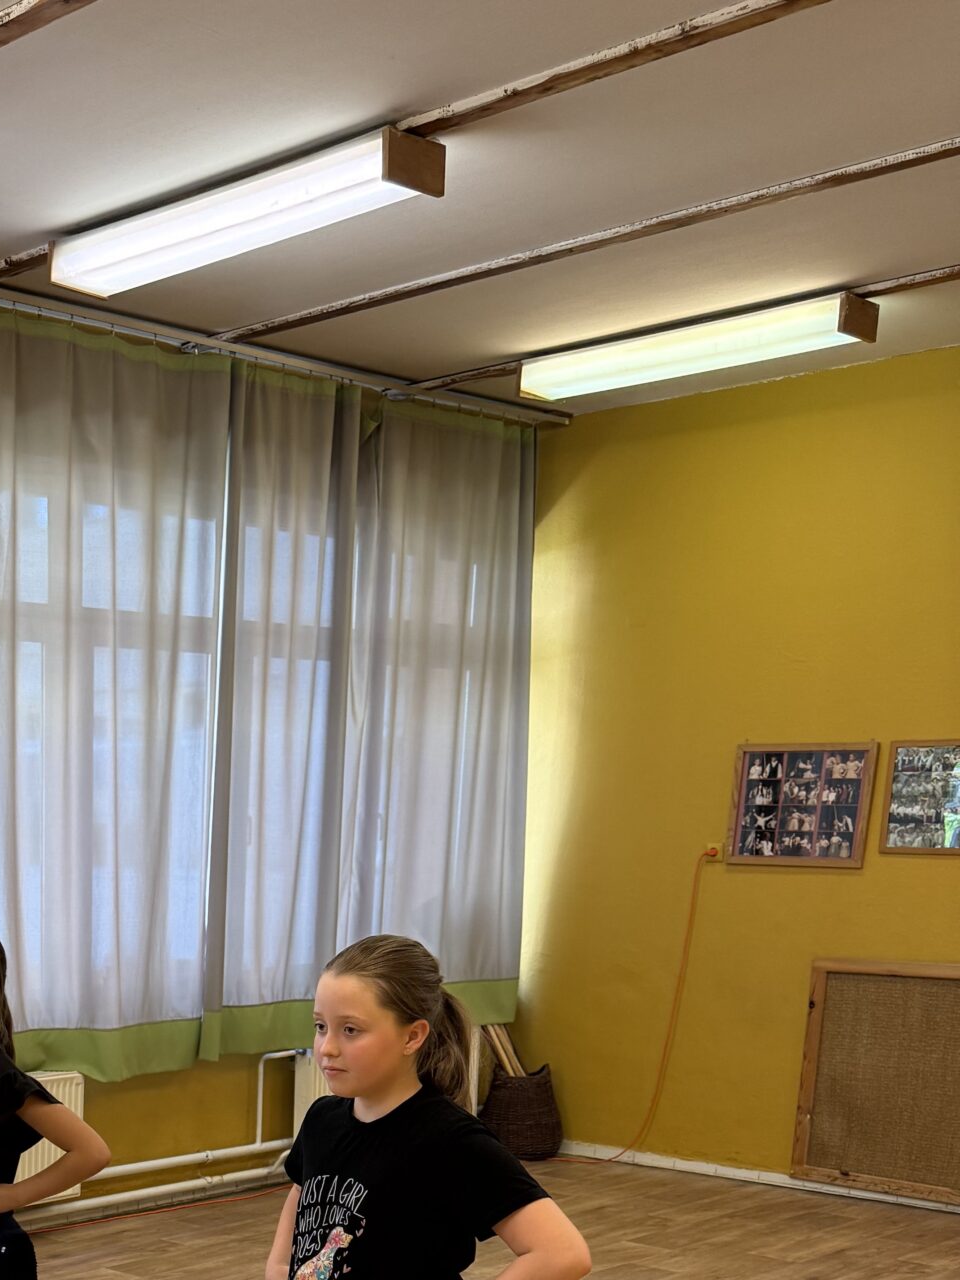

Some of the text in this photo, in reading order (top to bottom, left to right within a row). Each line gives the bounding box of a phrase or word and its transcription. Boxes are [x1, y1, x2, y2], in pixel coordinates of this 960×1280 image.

[297, 1174, 368, 1219] JUST A GIRL
[298, 1204, 351, 1233] WHO LOVES
[295, 1228, 323, 1259] DOGS
